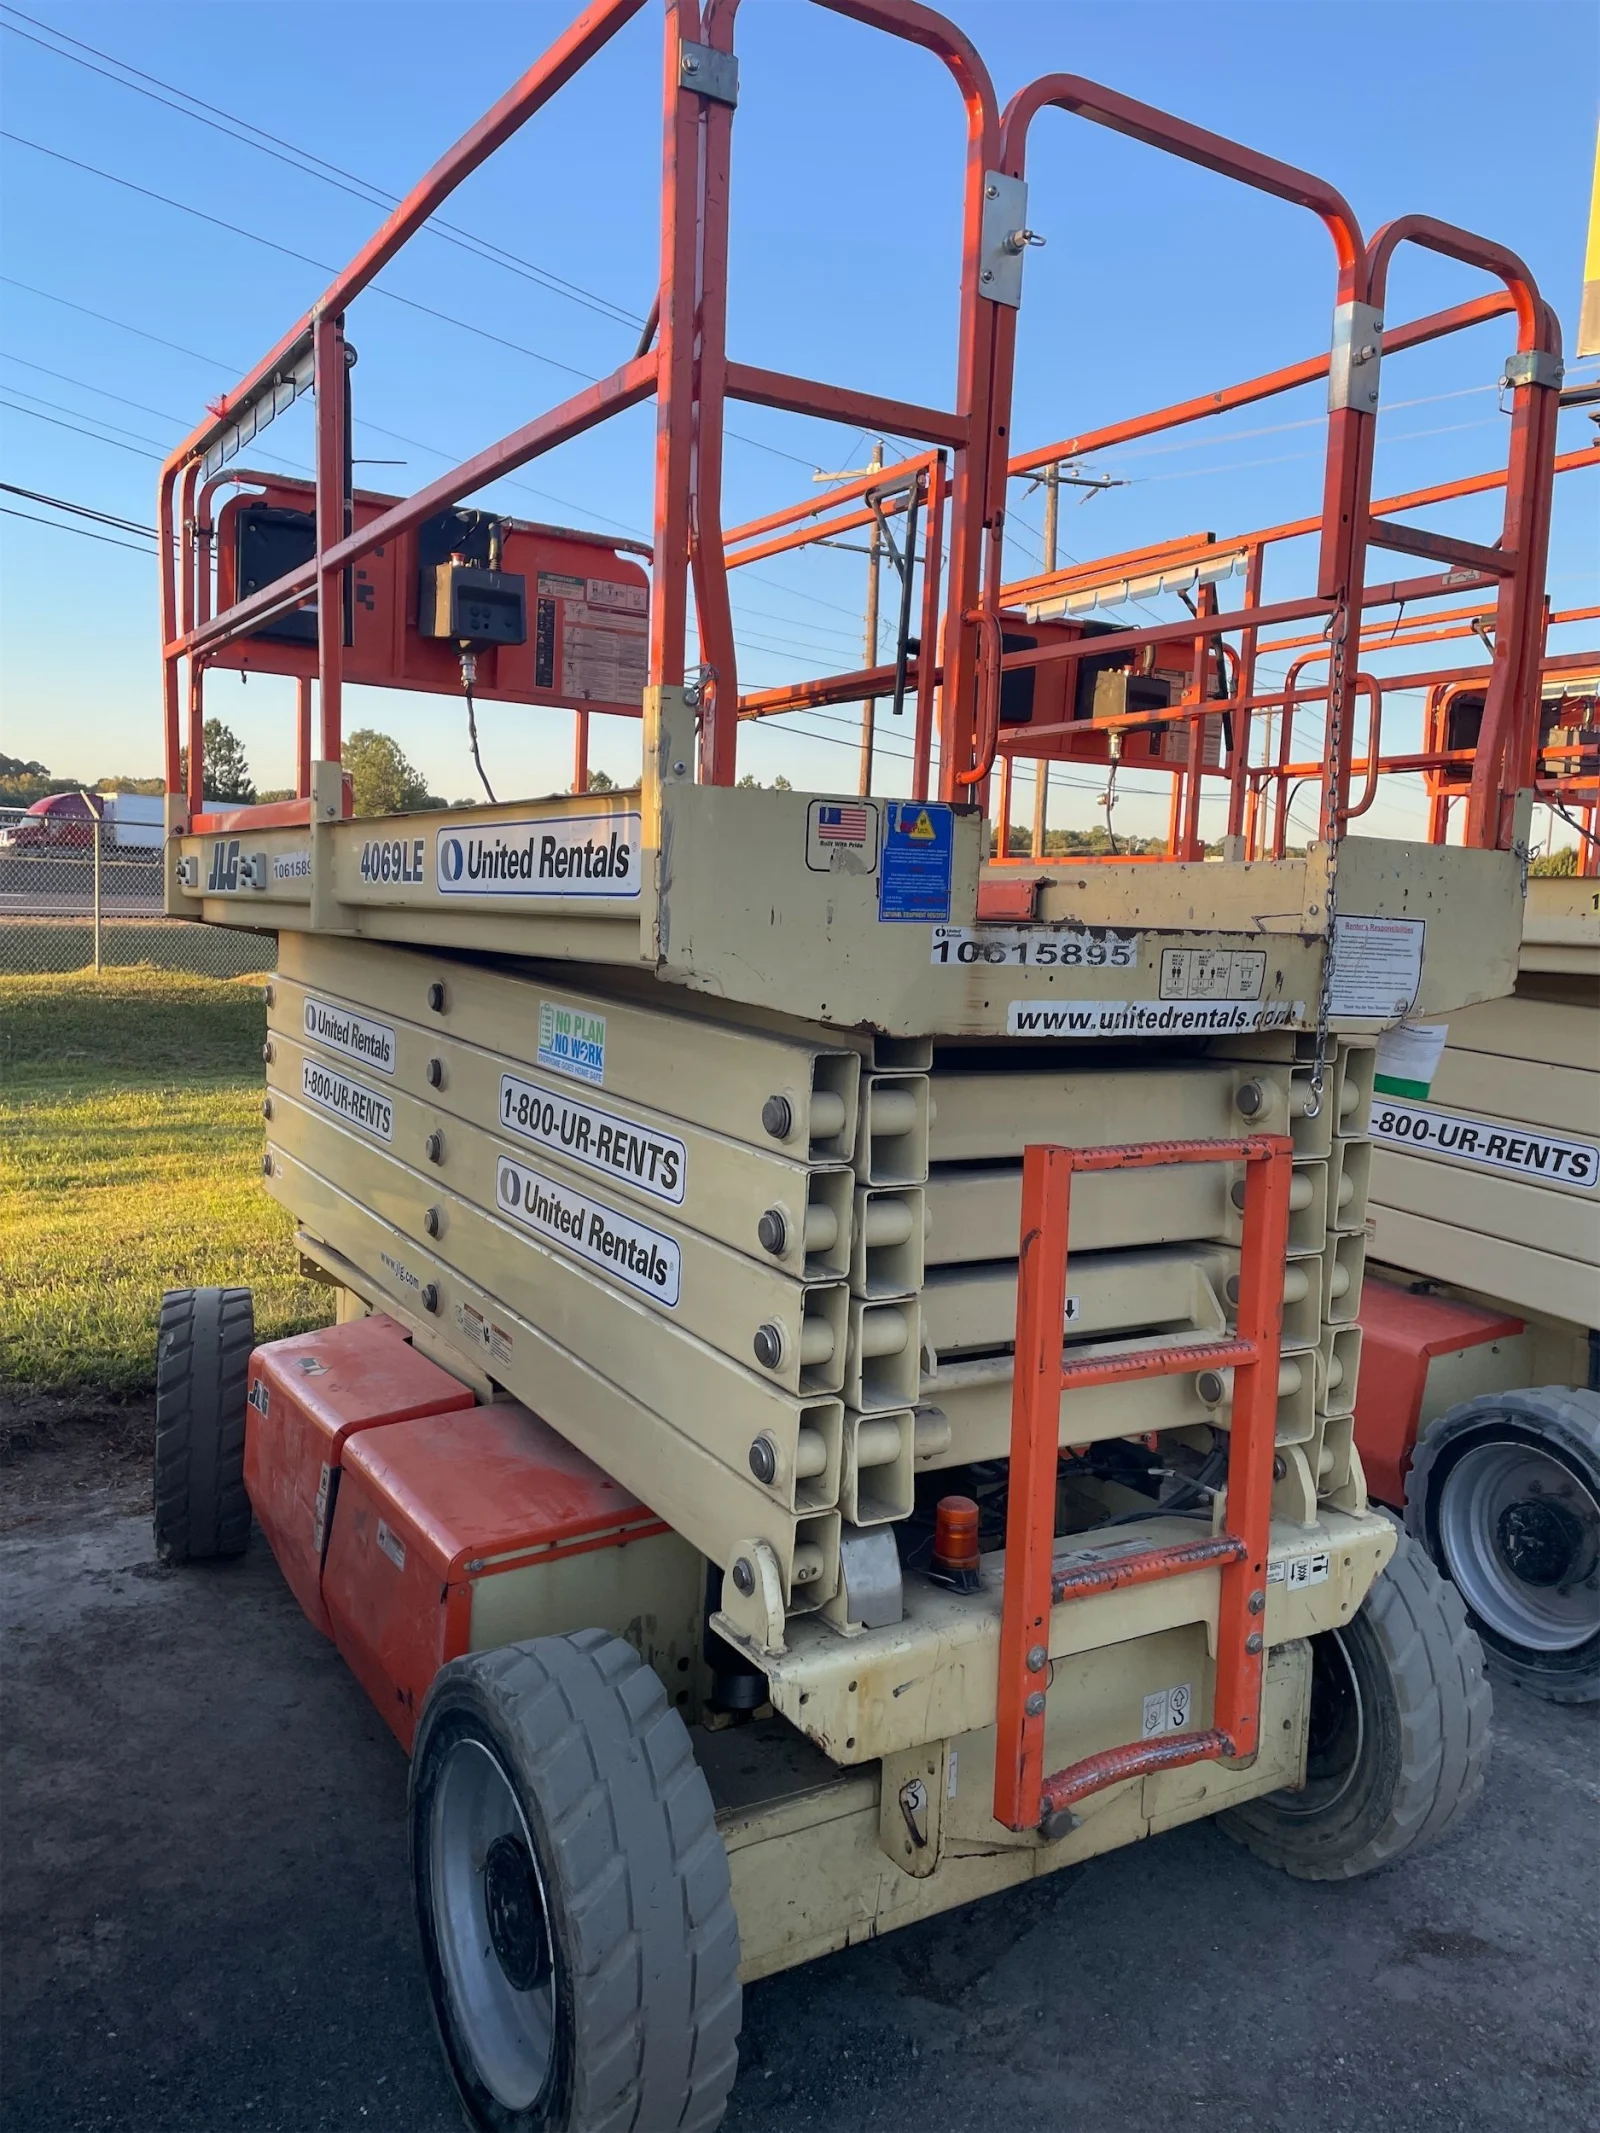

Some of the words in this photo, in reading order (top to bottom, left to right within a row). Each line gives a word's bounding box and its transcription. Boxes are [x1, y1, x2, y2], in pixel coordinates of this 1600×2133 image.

[208, 840, 241, 890] JLG
[360, 840, 424, 883] 4069LE
[468, 837, 534, 880] United
[539, 831, 630, 878] Rentals
[1345, 921, 1369, 931] Renter's
[1369, 923, 1413, 934] Responsibilities
[932, 940, 1131, 966] 10615895
[318, 1009, 350, 1045] United
[351, 1023, 390, 1062] Rentals
[556, 1010, 571, 1035] NO
[574, 1015, 604, 1046] PLAN
[1016, 1005, 1295, 1030] www.unitedrentals.com
[555, 1033, 569, 1055] NO
[571, 1037, 603, 1067] WORK
[304, 1067, 391, 1133] 1-800-UR-RENTS
[504, 1088, 679, 1190] 1-800-UR-RENTS
[524, 1180, 585, 1241] United
[588, 1213, 668, 1286] Rentals
[380, 1251, 419, 1291] www.jlg.com
